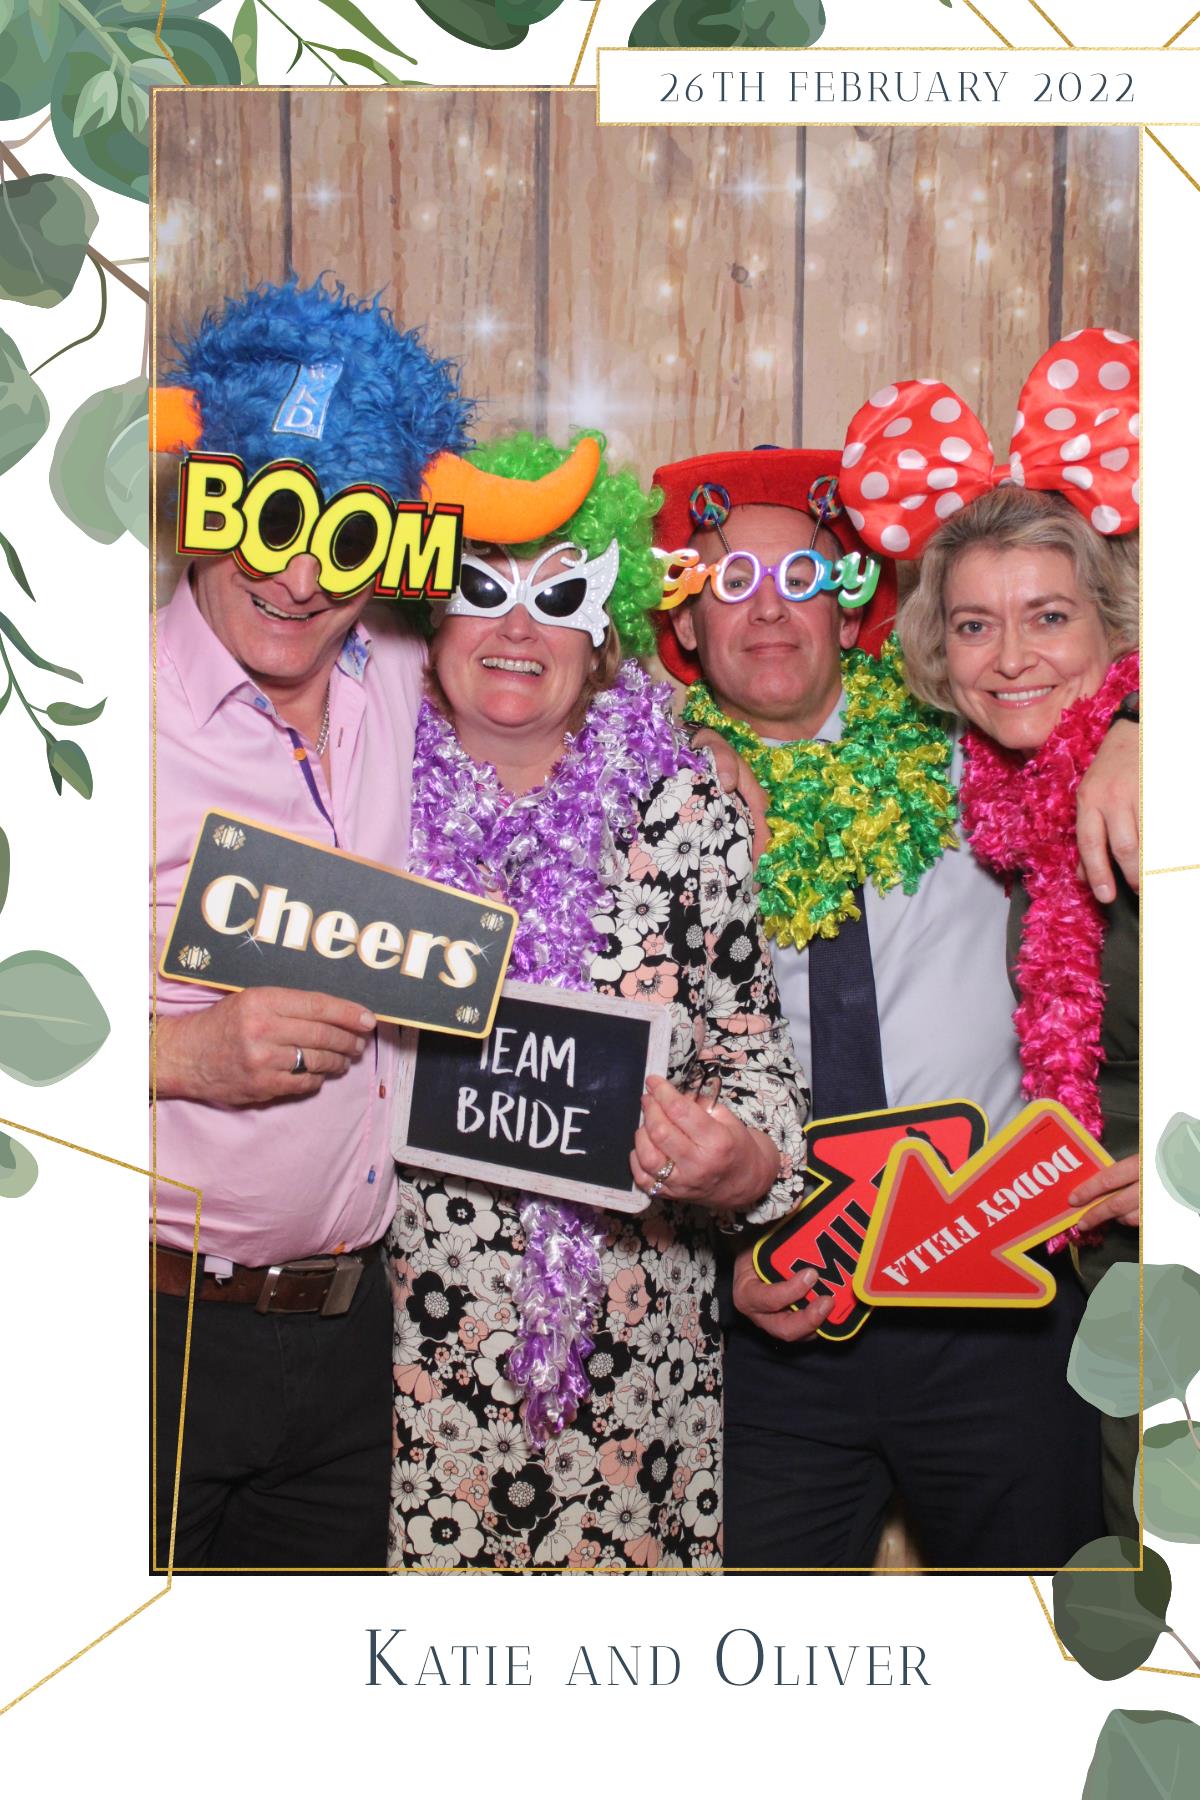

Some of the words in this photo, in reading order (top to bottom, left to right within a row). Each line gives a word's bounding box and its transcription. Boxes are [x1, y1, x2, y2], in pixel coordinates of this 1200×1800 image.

[179, 454, 461, 598] BOOM
[201, 874, 482, 989] Cheers
[456, 1086, 590, 1155] BRIDE
[976, 1144, 1083, 1228] DODGY
[881, 1214, 980, 1286] FELLA
